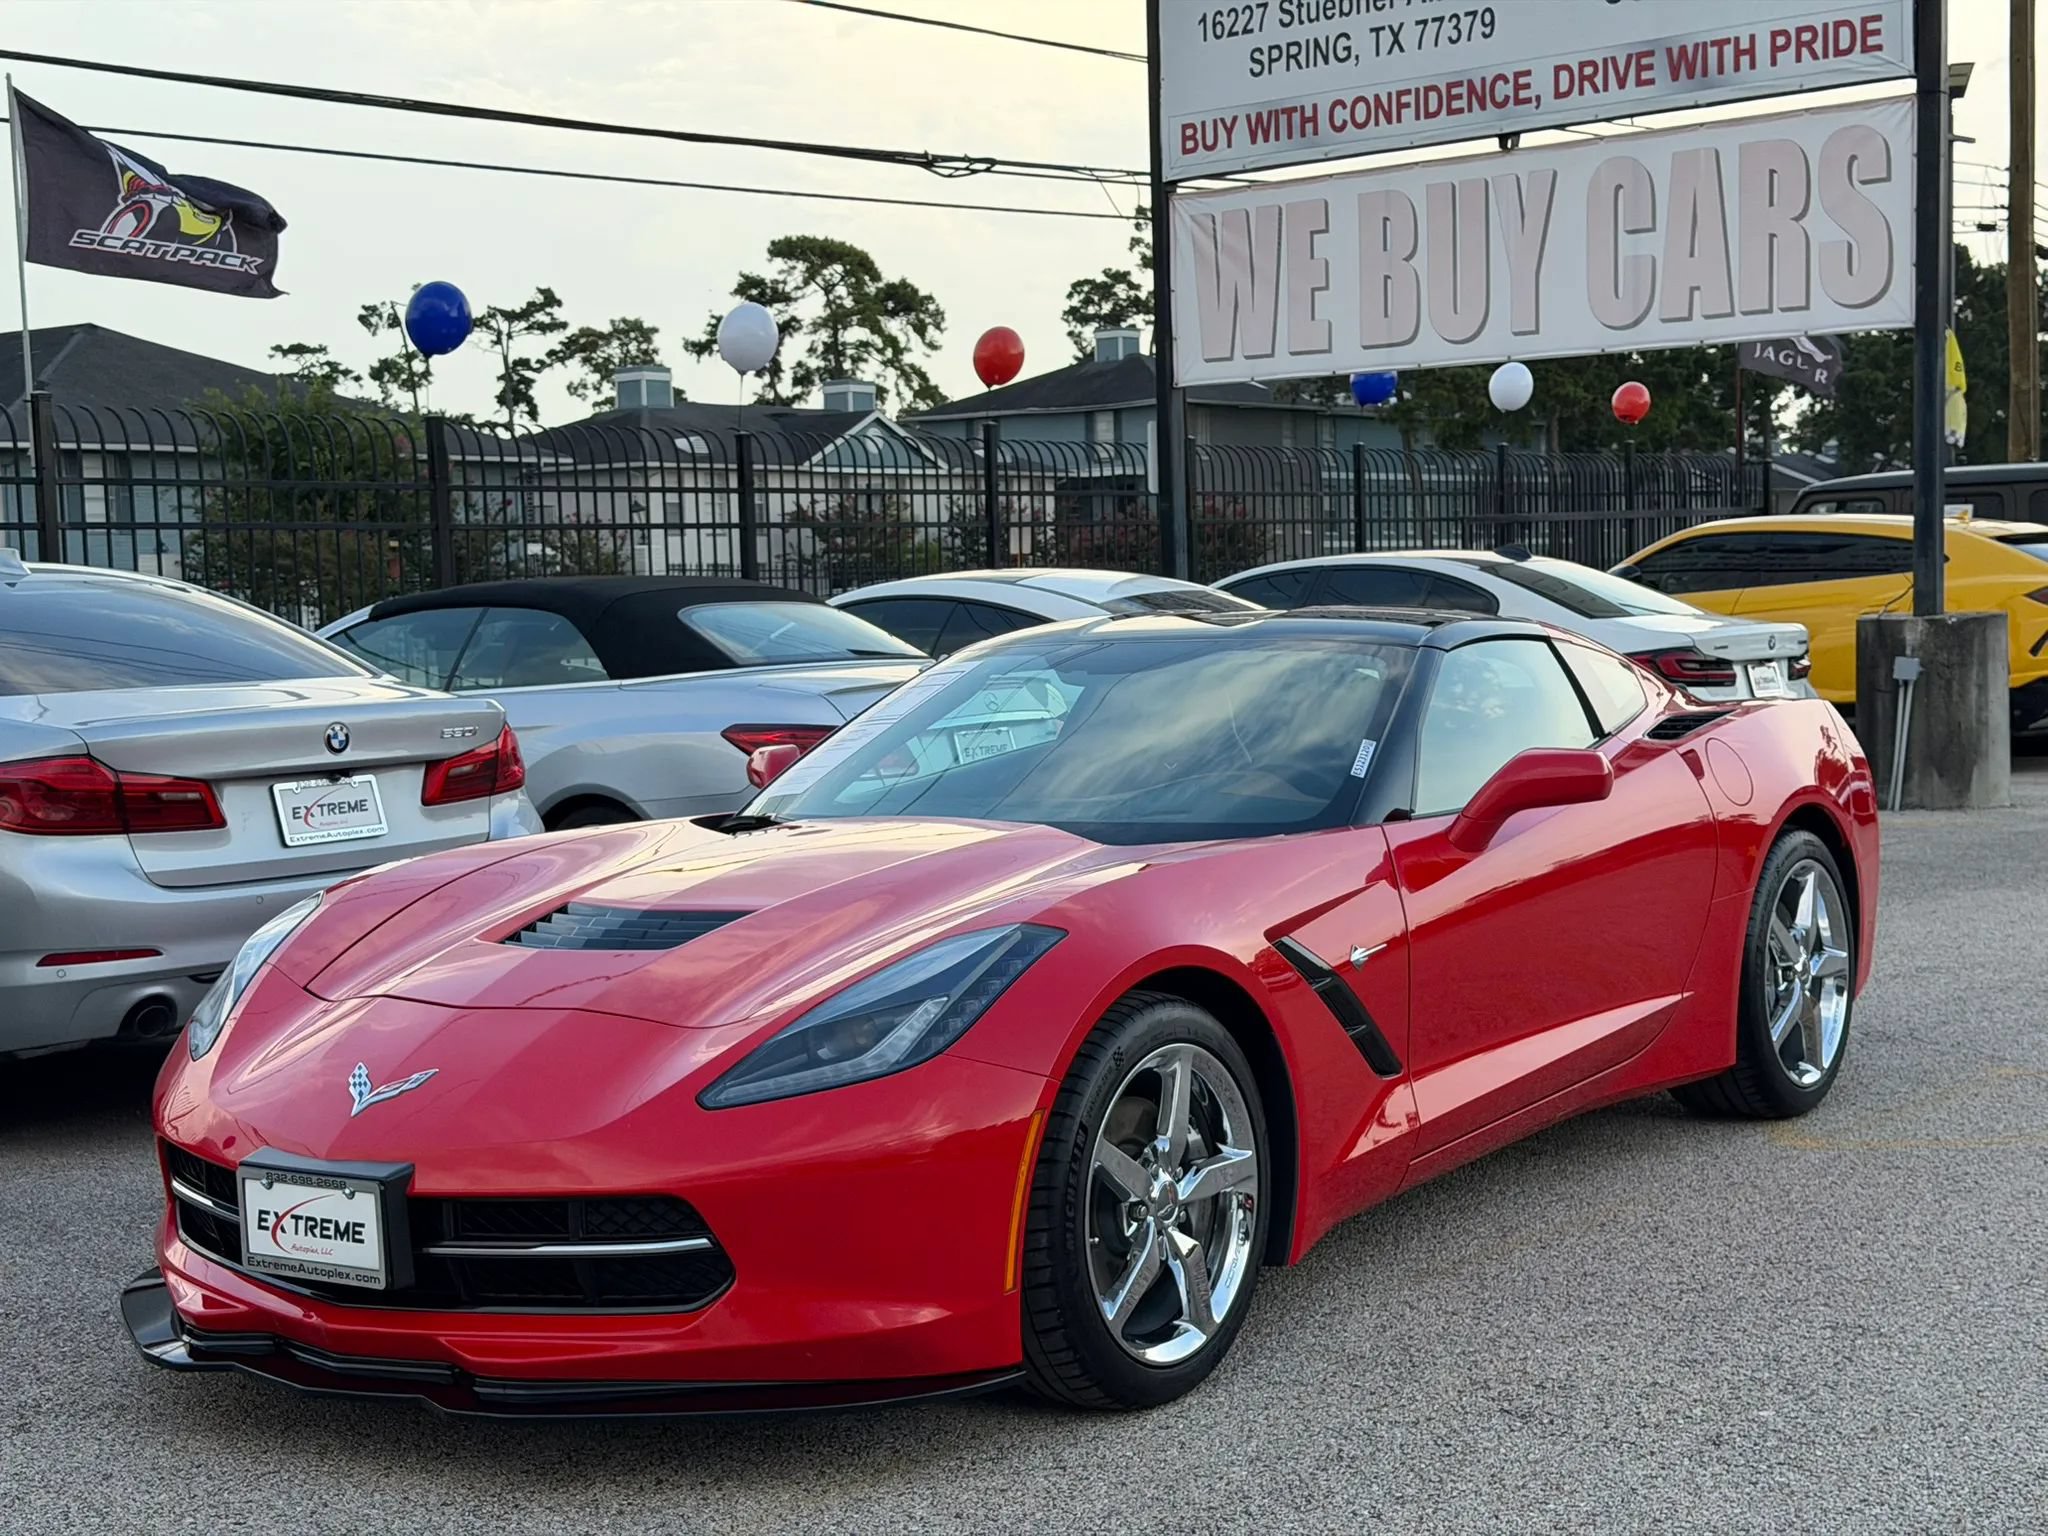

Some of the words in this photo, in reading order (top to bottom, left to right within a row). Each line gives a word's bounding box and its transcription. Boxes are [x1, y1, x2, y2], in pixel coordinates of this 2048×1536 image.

[1197, 3, 1269, 42] 16227
[1249, 32, 1360, 78] SPRING,
[1369, 22, 1406, 58] TX
[1415, 7, 1496, 51] 77379
[1180, 115, 1238, 156] BUY
[1246, 103, 1319, 145] WITH
[1328, 69, 1541, 134] CONFIDENCE,
[1553, 50, 1655, 100] DRIVE
[1666, 33, 1756, 82] WITH
[1769, 14, 1884, 67] PRIDE
[1190, 198, 1333, 363] WE
[1358, 168, 1558, 350] BUY
[1586, 124, 1894, 331] CARS
[1754, 342, 1829, 385] JAGR
[292, 799, 369, 820] EXTREME
[257, 1208, 366, 1244] EXTREME
[247, 1256, 381, 1285] ExtremeAutoplex.com
